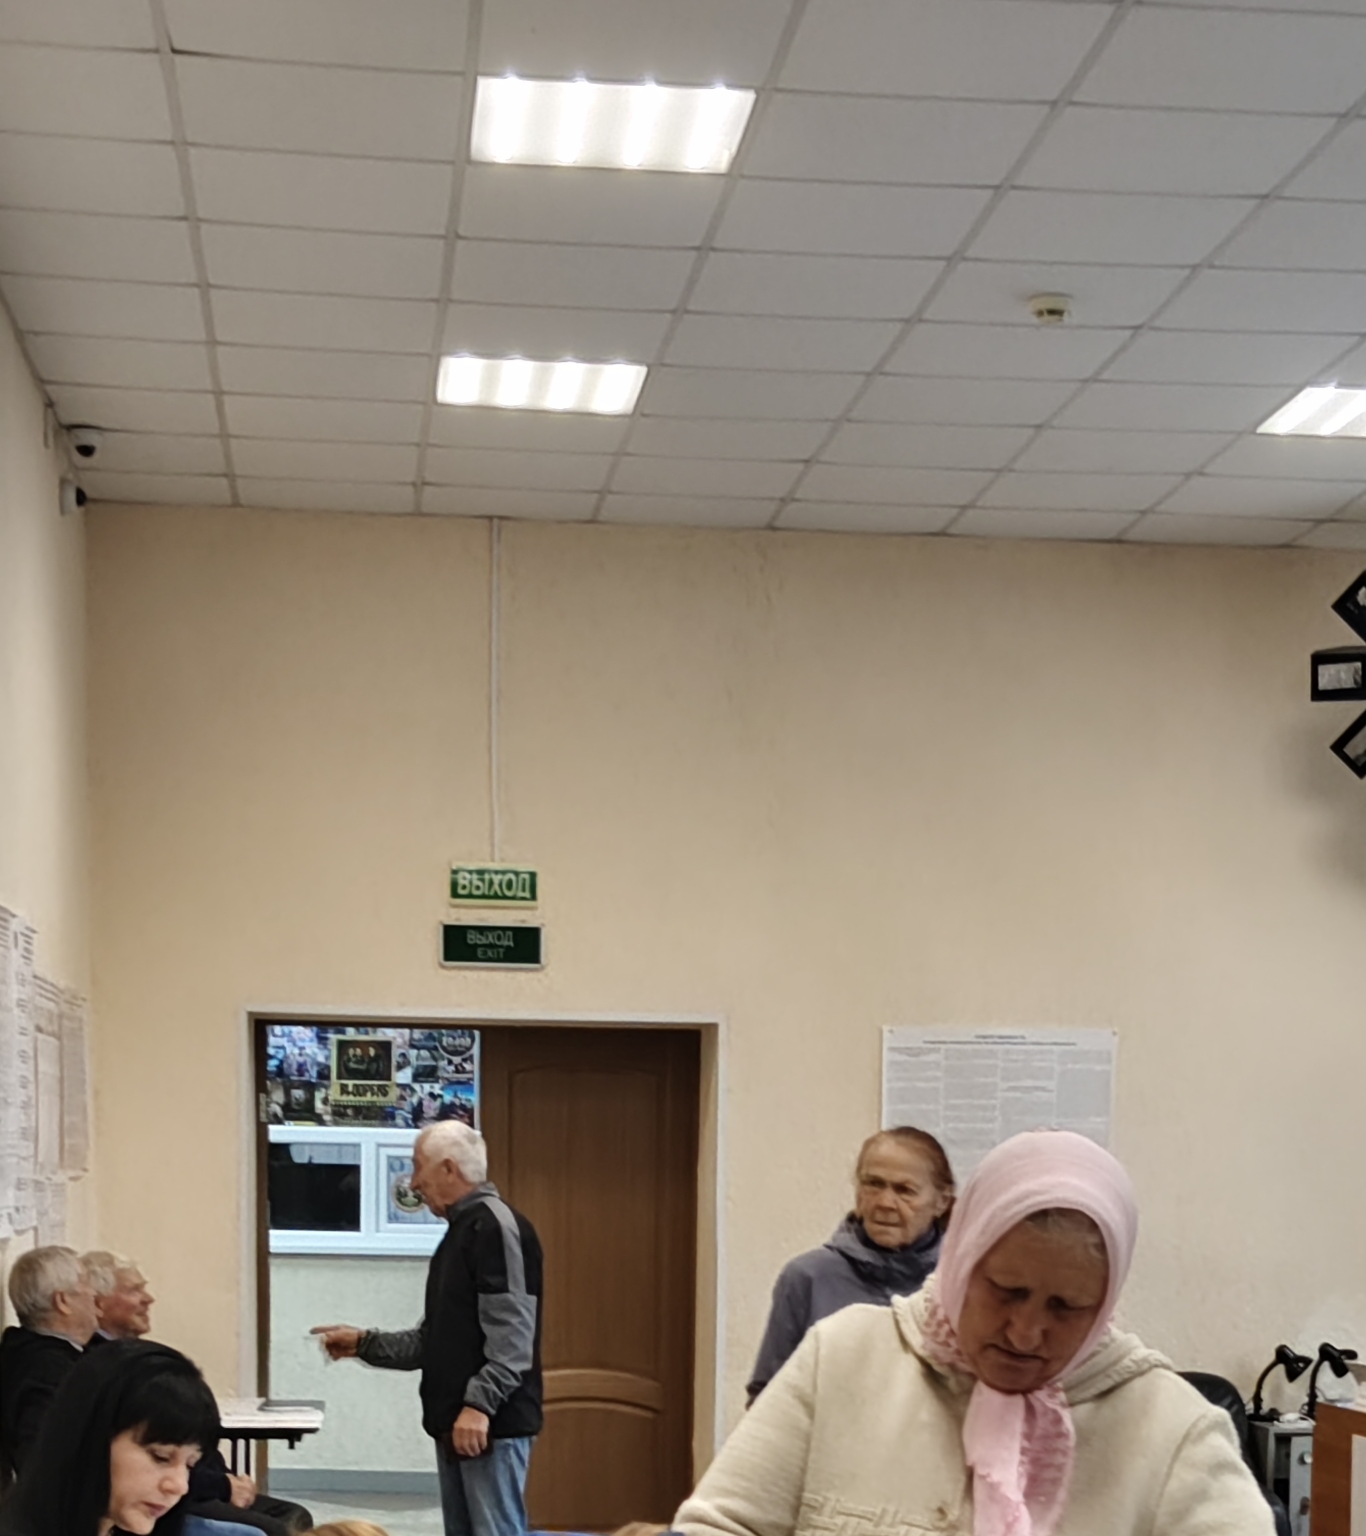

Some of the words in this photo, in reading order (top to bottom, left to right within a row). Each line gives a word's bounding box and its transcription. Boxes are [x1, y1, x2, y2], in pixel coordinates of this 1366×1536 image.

[457, 872, 531, 899] ВЫХОД
[467, 930, 514, 947] ВЫХОД
[477, 948, 505, 958] EXIT
